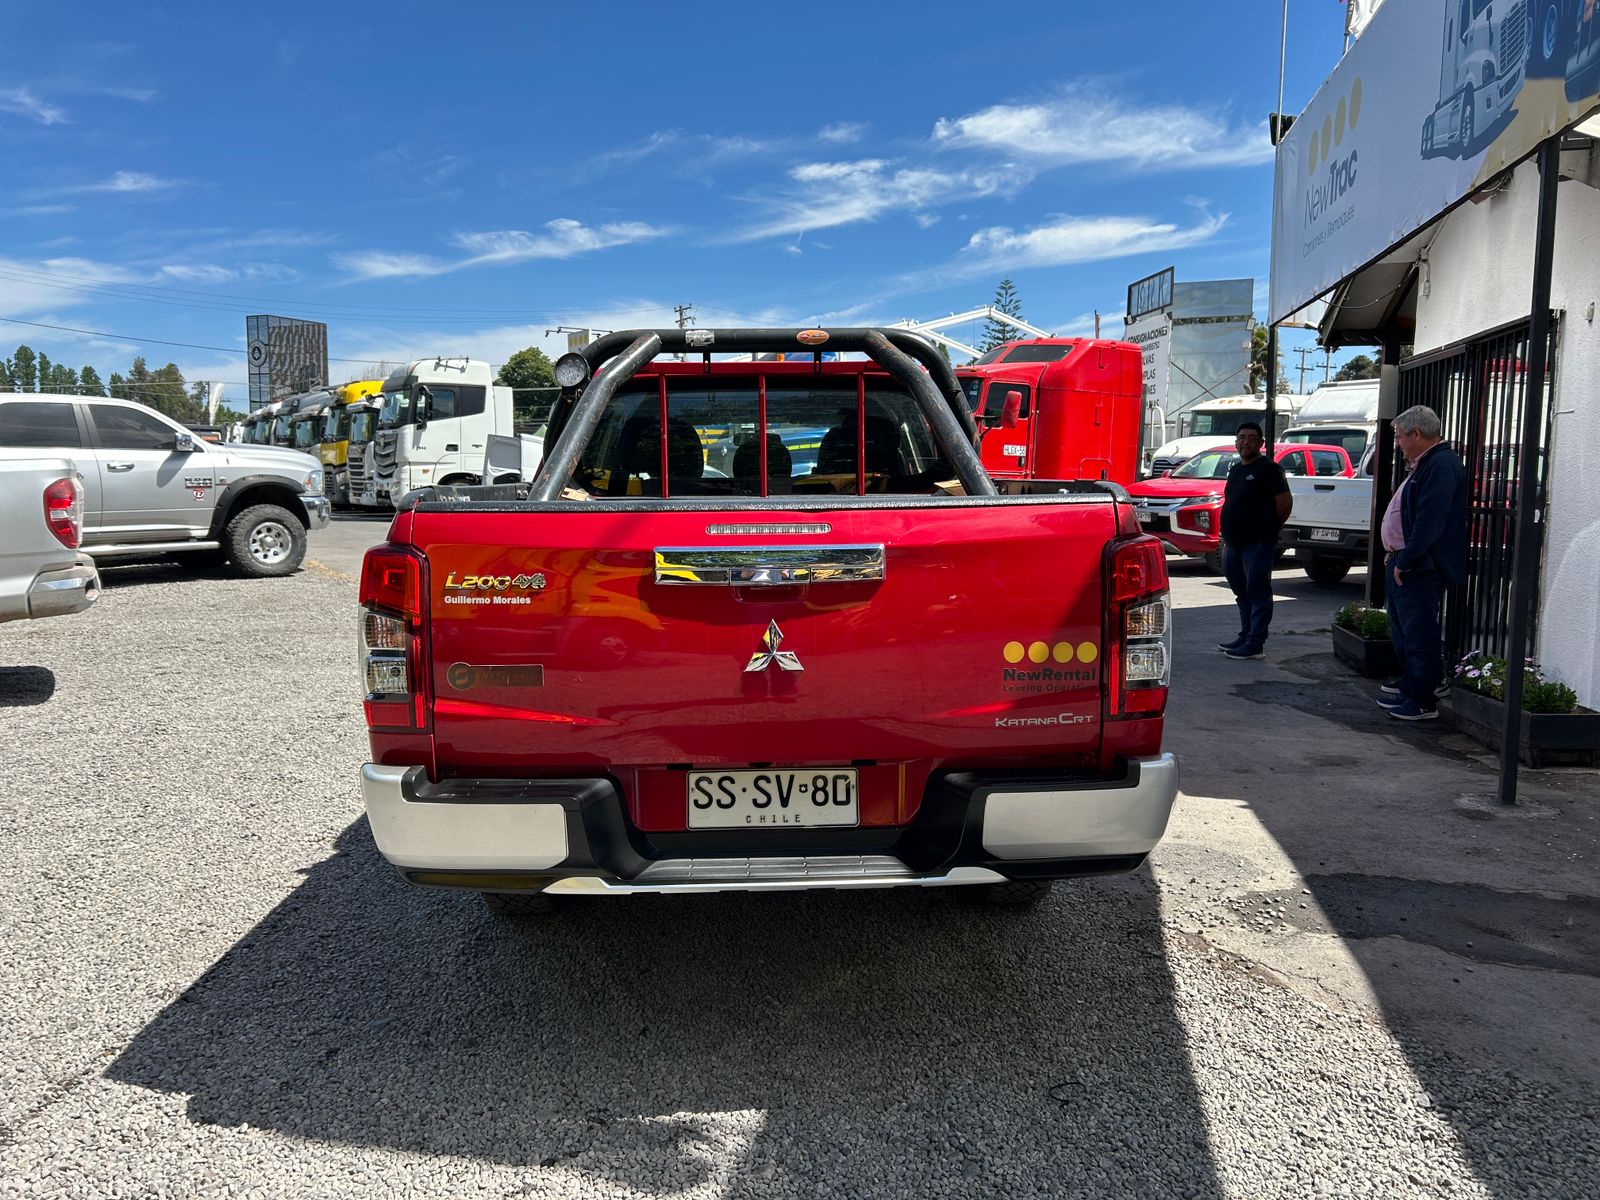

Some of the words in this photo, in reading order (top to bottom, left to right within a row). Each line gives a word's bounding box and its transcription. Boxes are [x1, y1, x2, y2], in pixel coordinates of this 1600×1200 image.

[1304, 149, 1358, 230] NewTrac
[445, 572, 511, 590] L200
[444, 595, 491, 605] Guillermo
[493, 595, 532, 605] Morales
[1003, 667, 1097, 681] NewRental
[745, 813, 801, 823] CHILE
